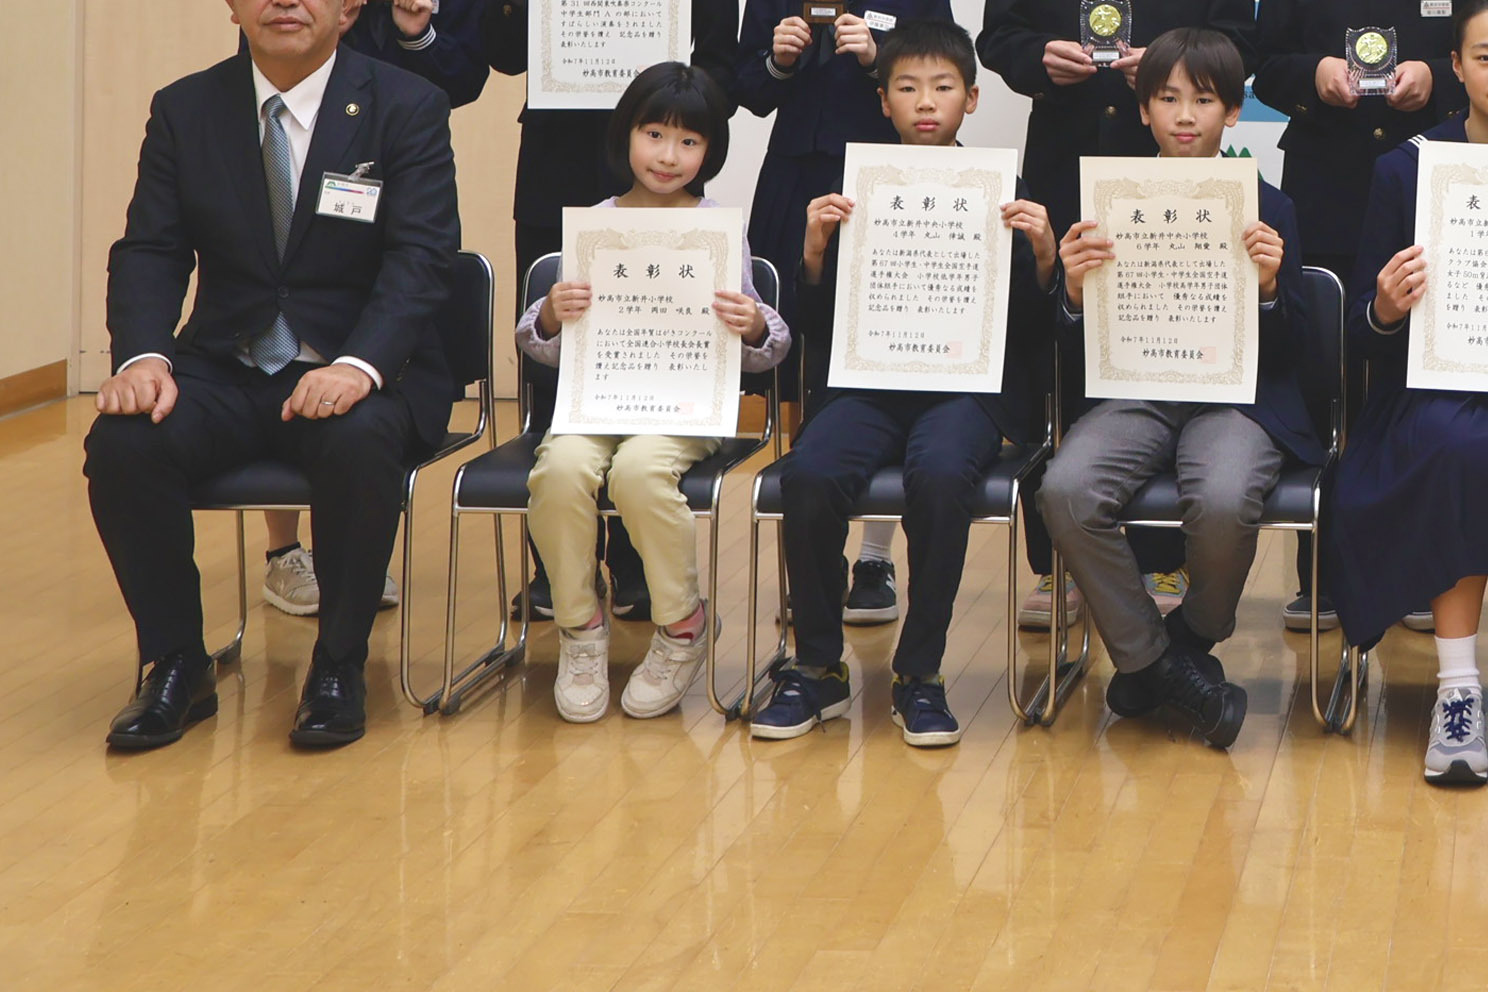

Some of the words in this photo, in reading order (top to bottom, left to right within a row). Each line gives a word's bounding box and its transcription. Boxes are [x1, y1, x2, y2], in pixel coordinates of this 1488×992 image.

[889, 195, 970, 213] 表彰状
[1130, 208, 1213, 225] 表彰状
[612, 262, 696, 280] 表彰状
